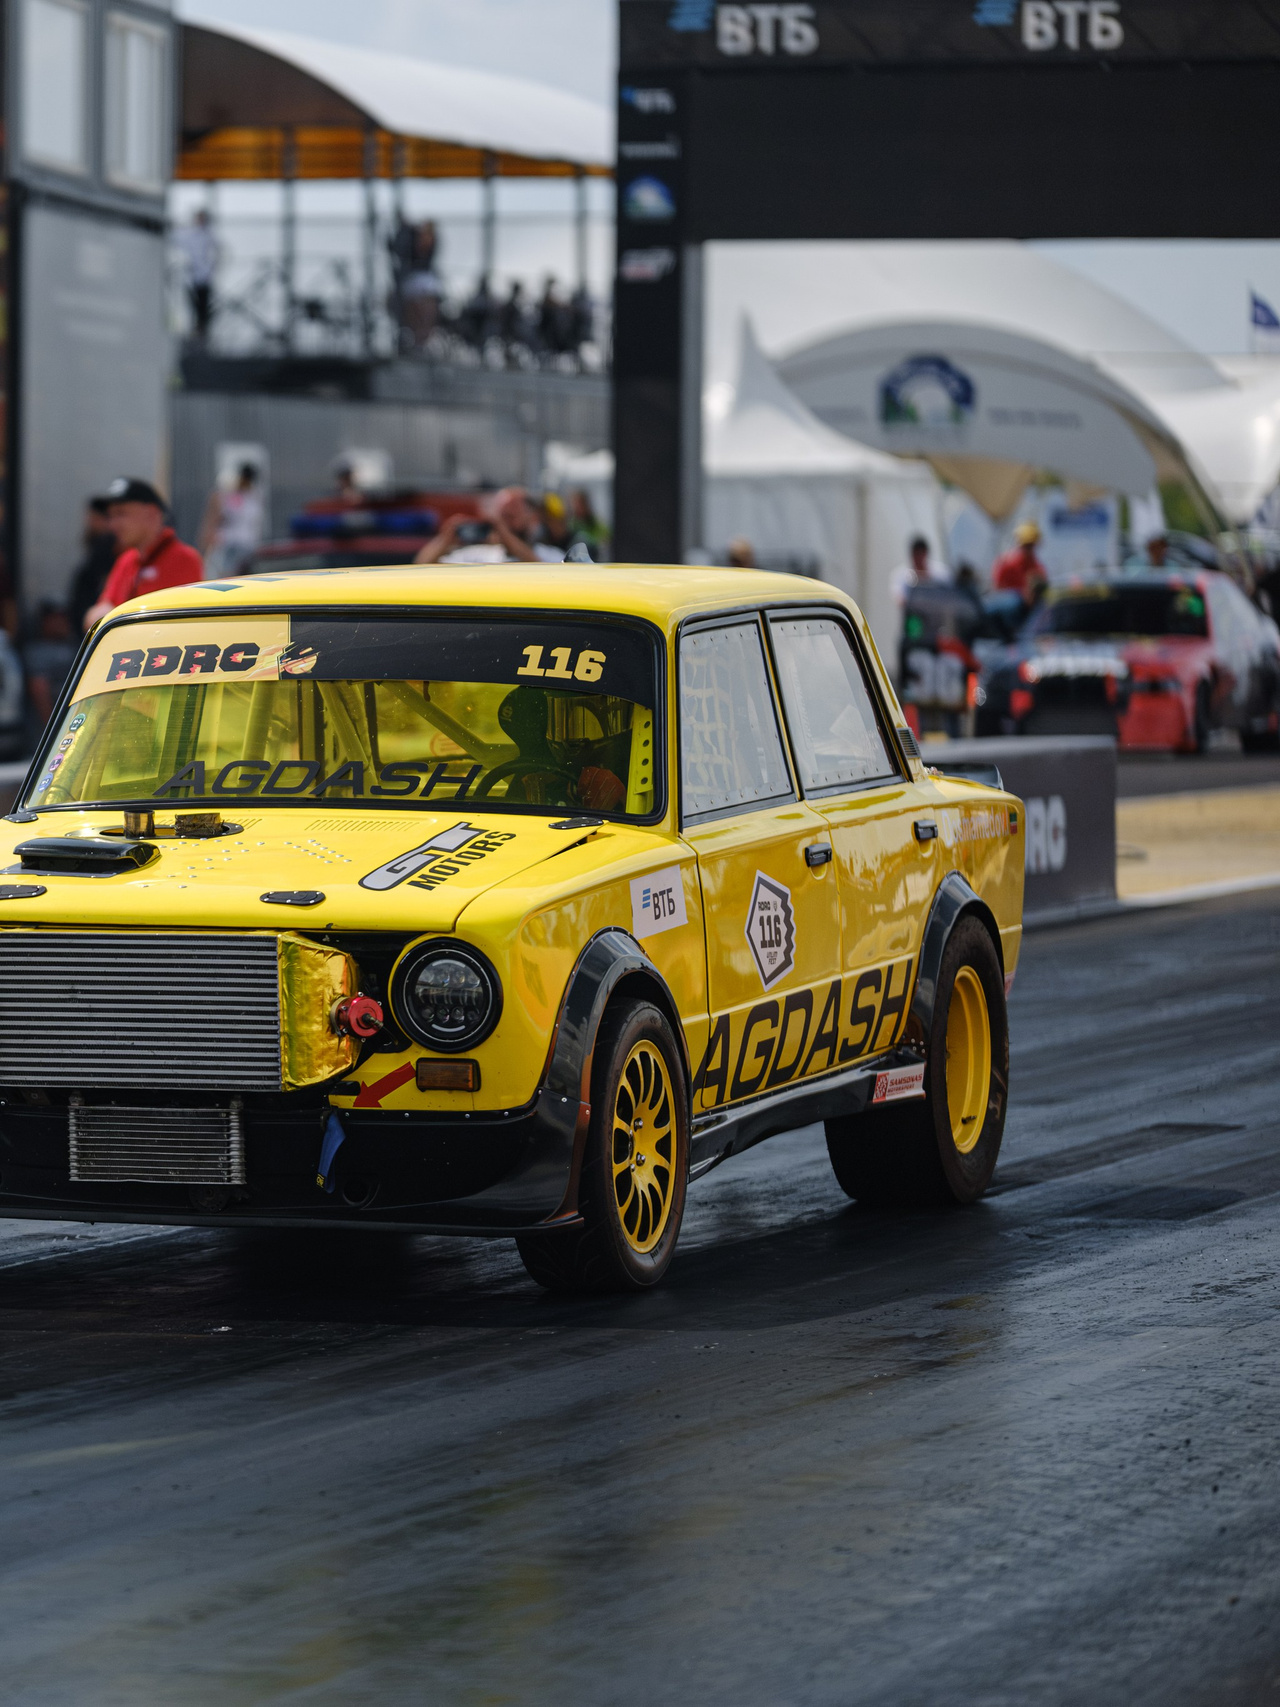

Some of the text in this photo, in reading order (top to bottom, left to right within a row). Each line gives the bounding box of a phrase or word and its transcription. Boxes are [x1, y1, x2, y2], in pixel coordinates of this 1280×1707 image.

[717, 4, 819, 56] ВТБ
[1021, 0, 1123, 51] ВТБ
[106, 642, 261, 682] RDRC
[516, 645, 607, 682] 116
[151, 760, 483, 800] AGDASH
[1025, 795, 1067, 874] RC
[406, 831, 517, 891] MOTORS
[652, 887, 676, 920] ВТБ
[759, 914, 782, 949] 116
[692, 958, 913, 1107] AGDASH
